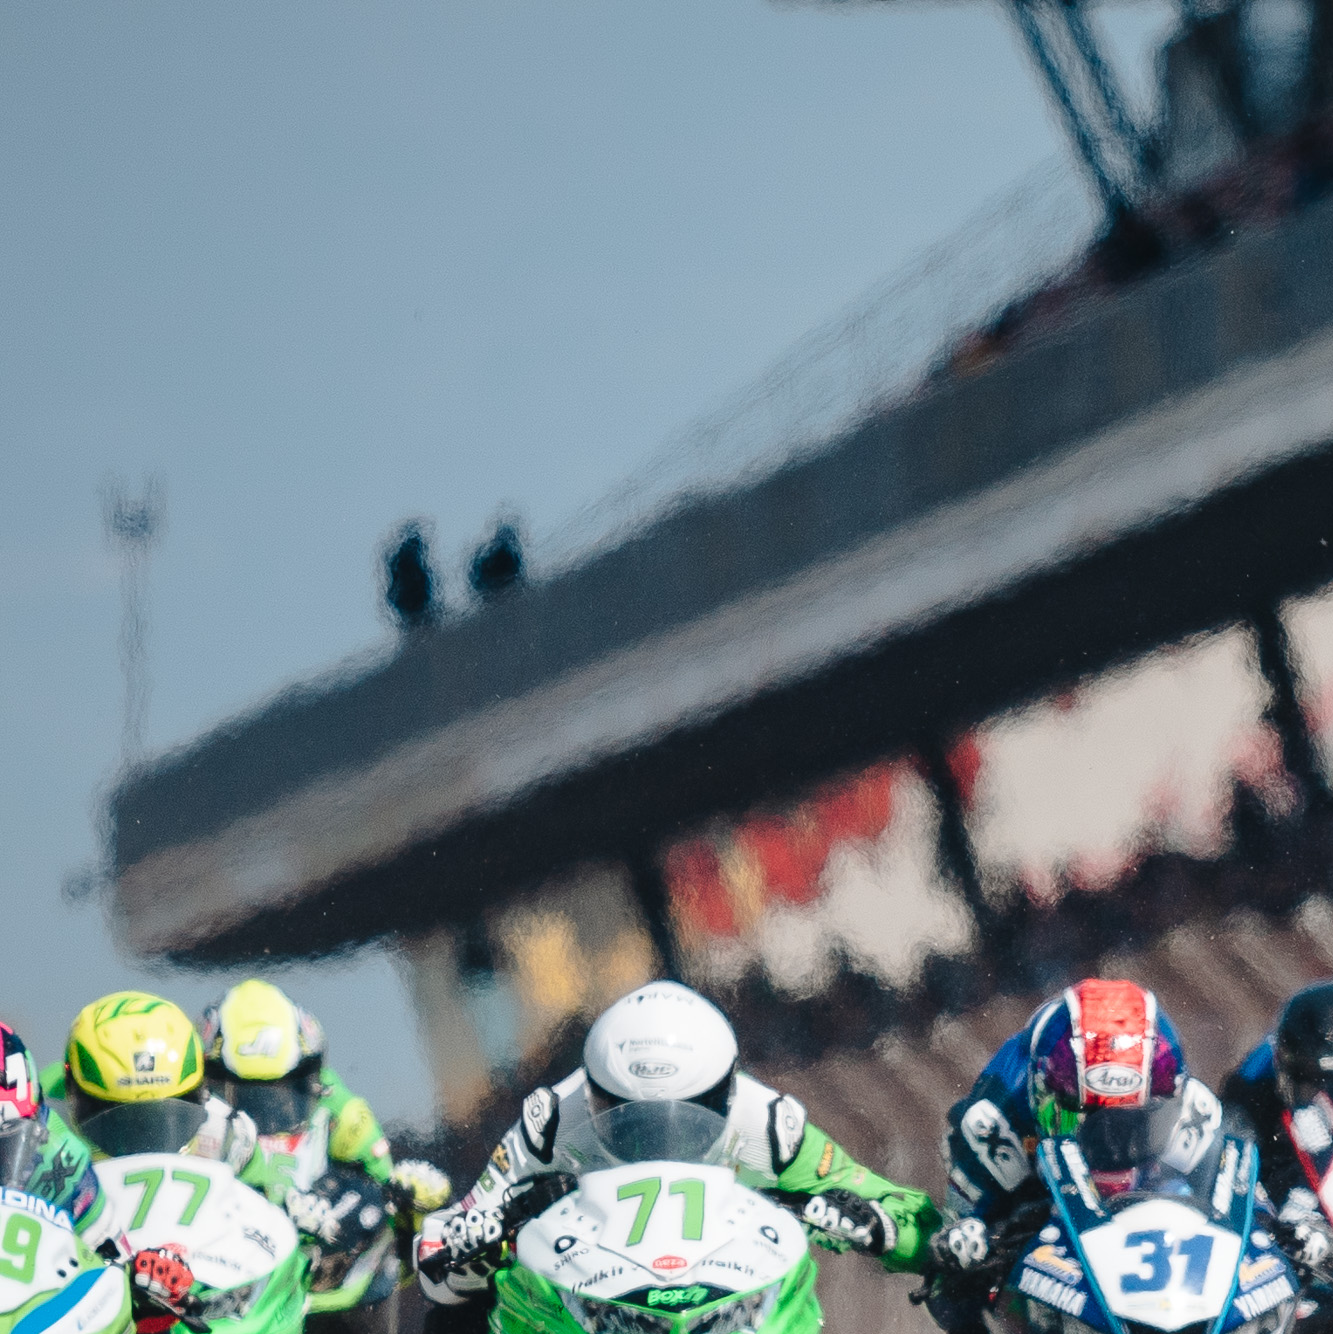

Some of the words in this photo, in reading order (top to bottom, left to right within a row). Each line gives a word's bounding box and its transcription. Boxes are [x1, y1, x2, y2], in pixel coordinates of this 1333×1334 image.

[124, 1168, 210, 1231] 77
[617, 1177, 705, 1247] 71
[1120, 1230, 1215, 1296] 31
